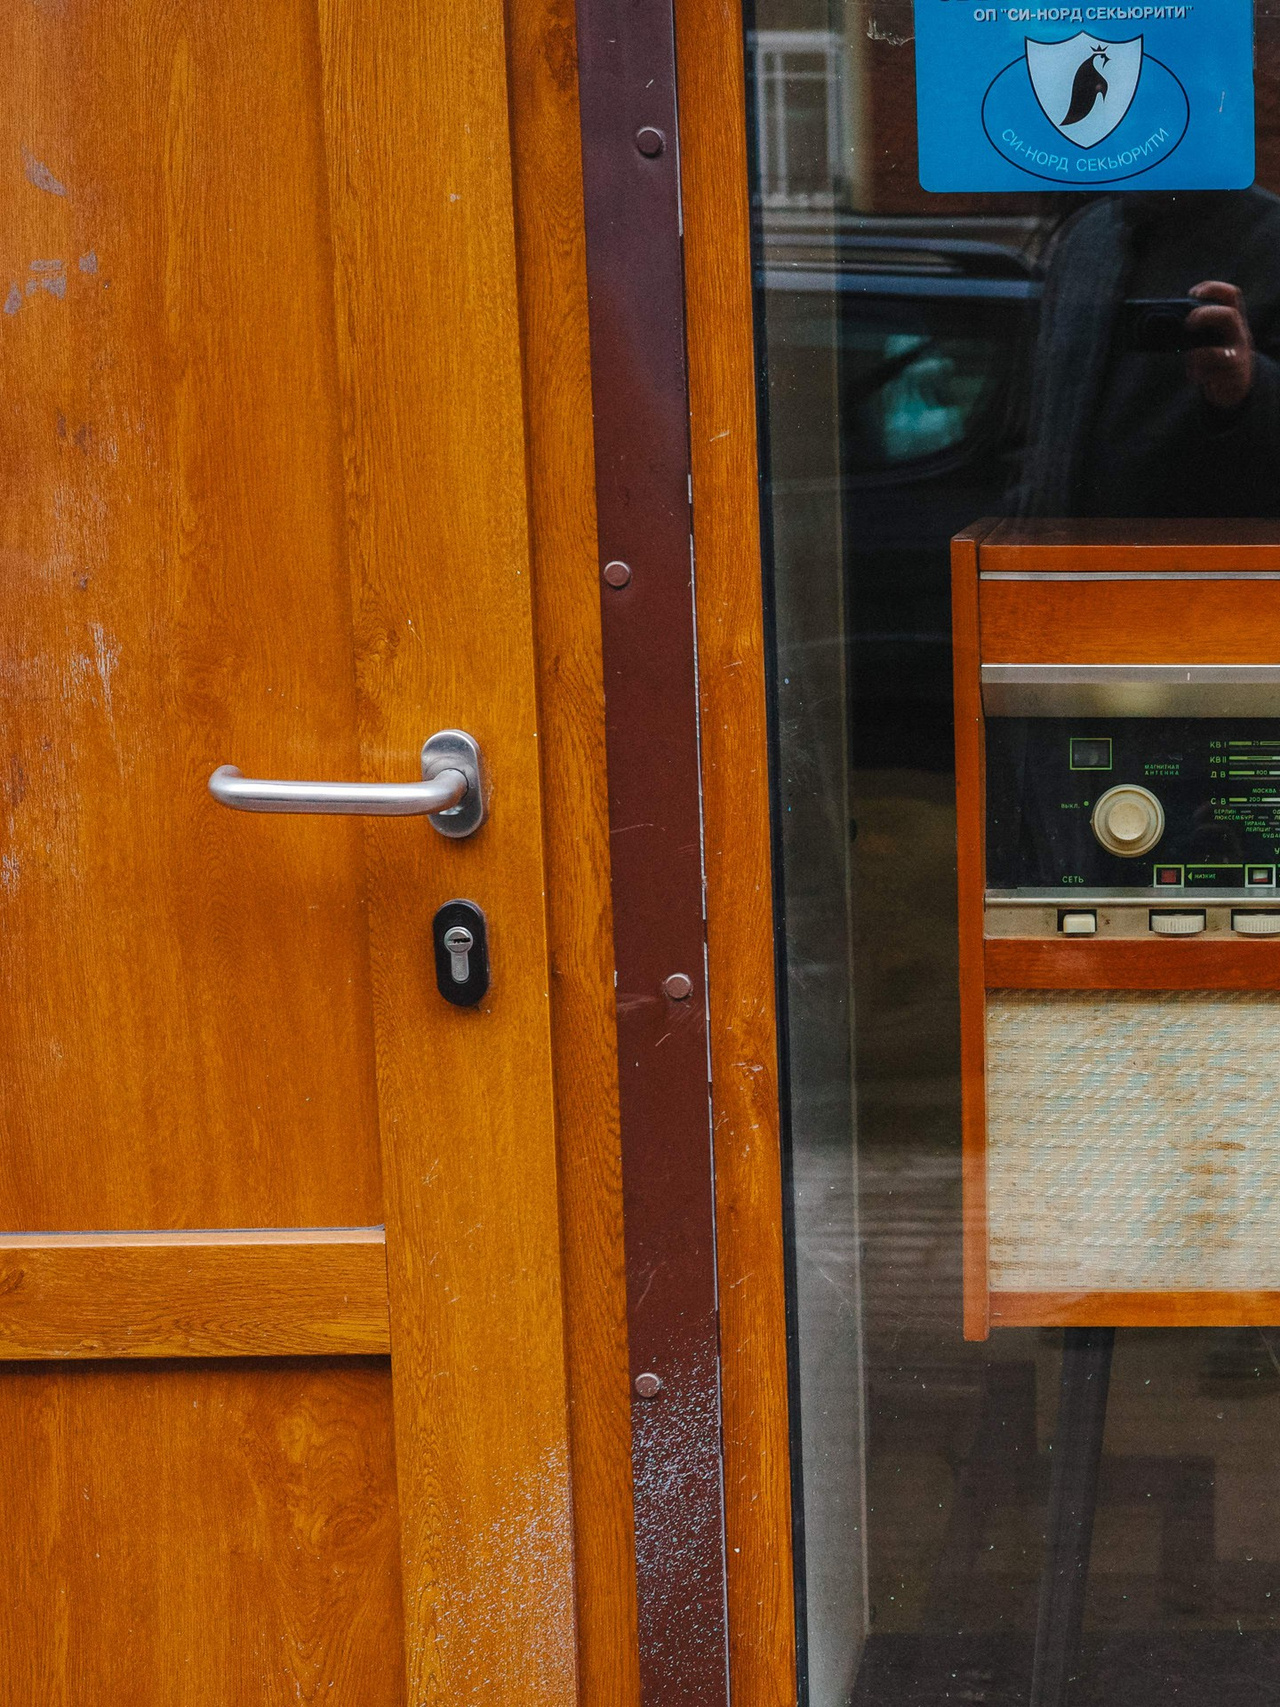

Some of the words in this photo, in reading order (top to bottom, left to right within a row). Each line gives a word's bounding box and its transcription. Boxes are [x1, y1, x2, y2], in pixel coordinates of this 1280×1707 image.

[973, 8, 998, 21] ОП
[1001, 7, 1082, 23] "СИ-НОРД
[1086, 6, 1194, 20] СЕКЬЮРИТИ"
[1001, 128, 1069, 173] СИ-НОРД
[1076, 127, 1169, 173] СЕКЬЮРИТИ
[1062, 876, 1084, 884] СЕТЬ
